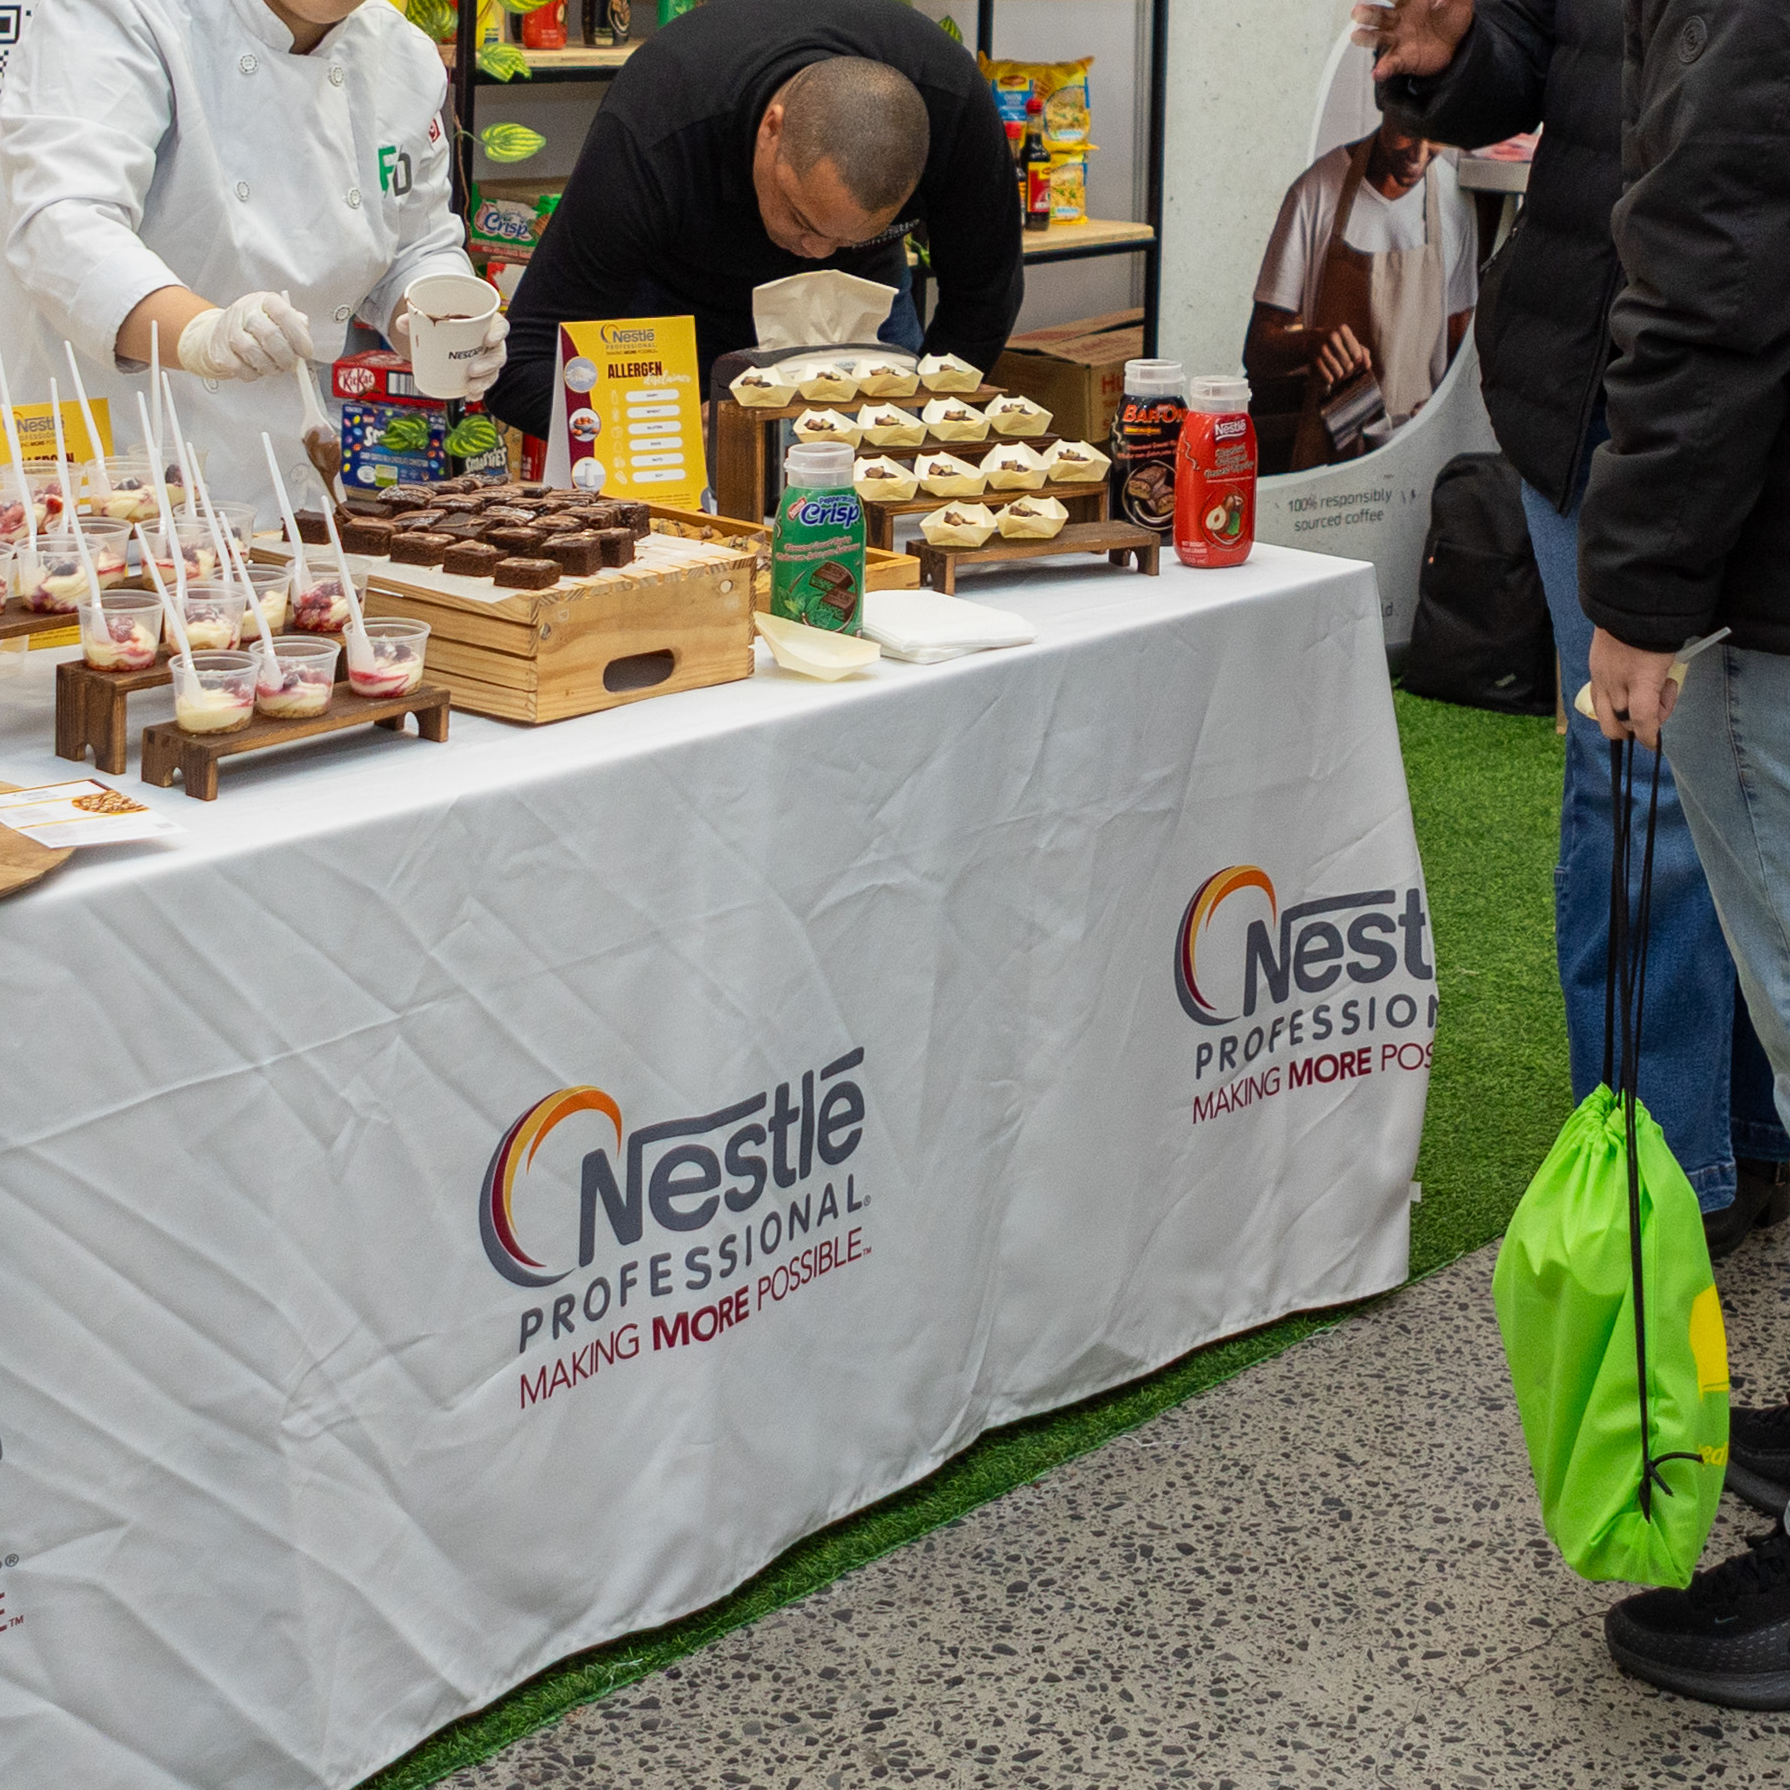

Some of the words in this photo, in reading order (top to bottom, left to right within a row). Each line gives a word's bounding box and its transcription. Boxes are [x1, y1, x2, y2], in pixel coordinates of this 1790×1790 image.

[485, 212, 528, 237] Crisp
[613, 329, 655, 343] Nestlé
[342, 367, 373, 393] KitKat
[608, 361, 663, 379] ALLERGEN
[17, 415, 65, 433] Nestl
[1289, 495, 1317, 512] 100%
[1320, 488, 1392, 509] responsibly
[800, 502, 860, 529] Crisp
[1295, 513, 1341, 532] sourced
[1345, 509, 1384, 526] coffee
[1244, 888, 1434, 1017] Nest
[1196, 993, 1439, 1080] PROFESSIO
[1192, 1067, 1281, 1124] MAKING
[1289, 1046, 1373, 1090] MORE
[580, 1047, 866, 1268] Nestlé
[520, 1173, 863, 1354] PROFESSIONAL
[520, 1324, 639, 1409] MAKING
[652, 1285, 749, 1351] MORE
[757, 1226, 862, 1312] POSSIBLE
